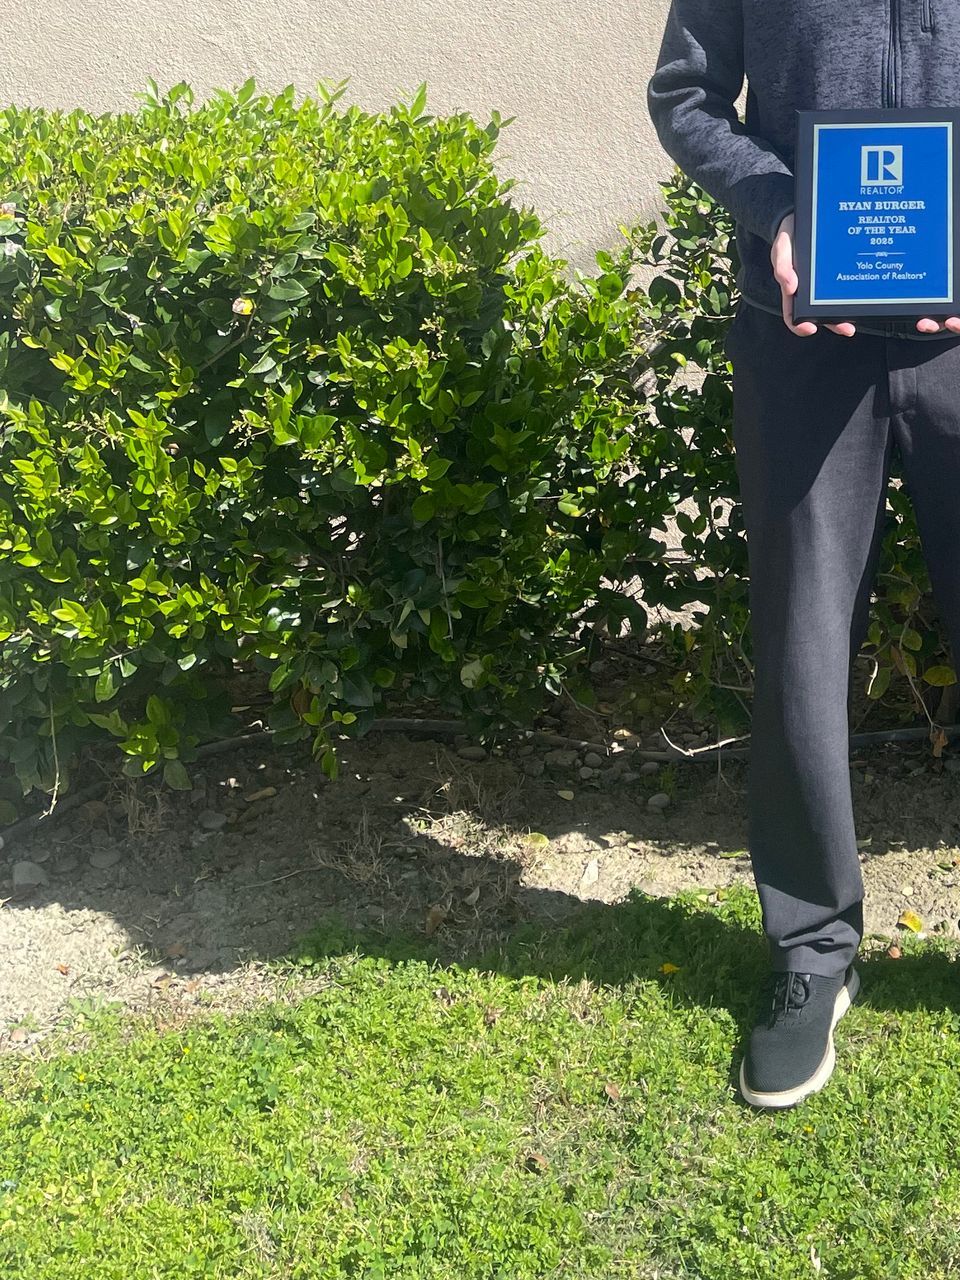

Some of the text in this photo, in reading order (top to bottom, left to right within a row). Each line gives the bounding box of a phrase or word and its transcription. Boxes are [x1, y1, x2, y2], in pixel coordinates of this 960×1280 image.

[839, 200, 925, 211] RYAN BURGER
[858, 215, 906, 224] REALTOR
[848, 225, 916, 235] OF THE YEAR
[870, 237, 894, 245] 2025
[856, 261, 904, 271] Yolo County
[836, 272, 880, 281] Association
[881, 271, 890, 280] of
